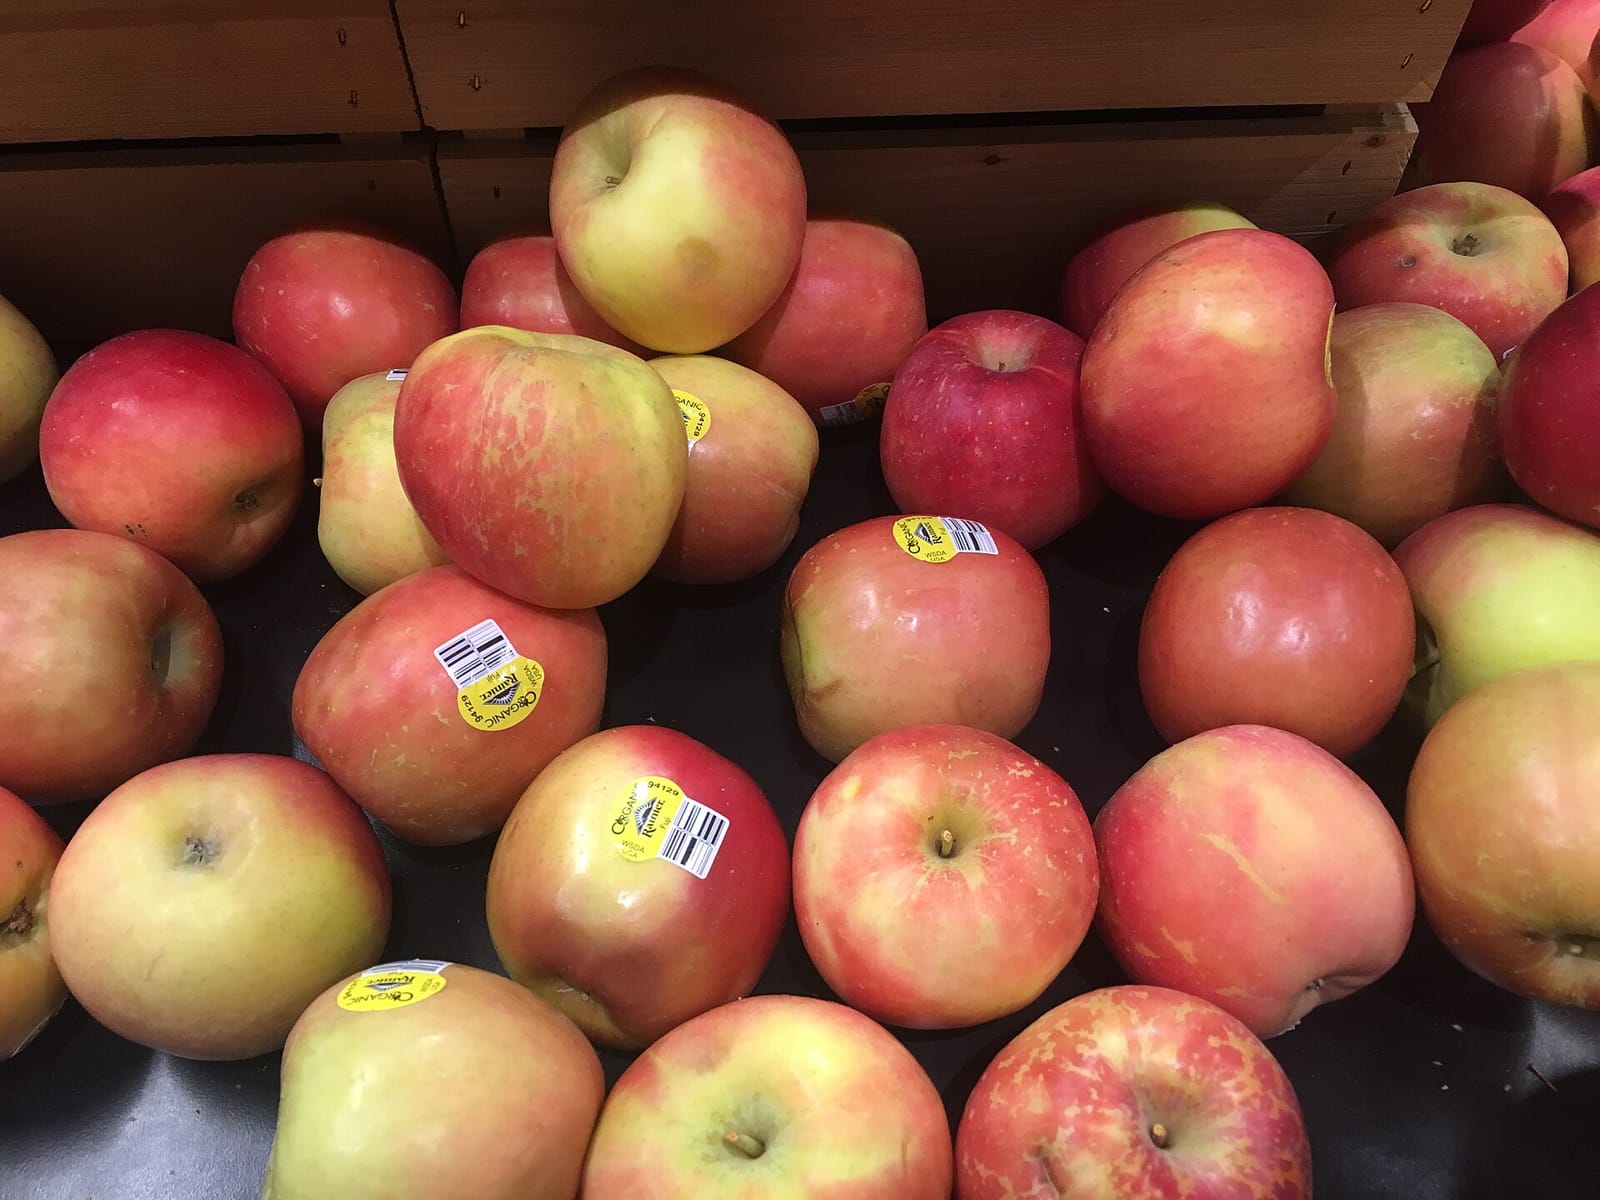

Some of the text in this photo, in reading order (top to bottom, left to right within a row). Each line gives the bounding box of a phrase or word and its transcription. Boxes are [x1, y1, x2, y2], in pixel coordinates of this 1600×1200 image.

[675, 396, 704, 411] GANIC
[693, 412, 706, 437] 94129
[925, 550, 947, 559] WSDA
[461, 694, 484, 723] 94129
[484, 691, 537, 728] ORGANIC
[648, 780, 680, 797] 94129
[621, 839, 646, 854] WSDA
[345, 990, 414, 1006] ORGANIC
